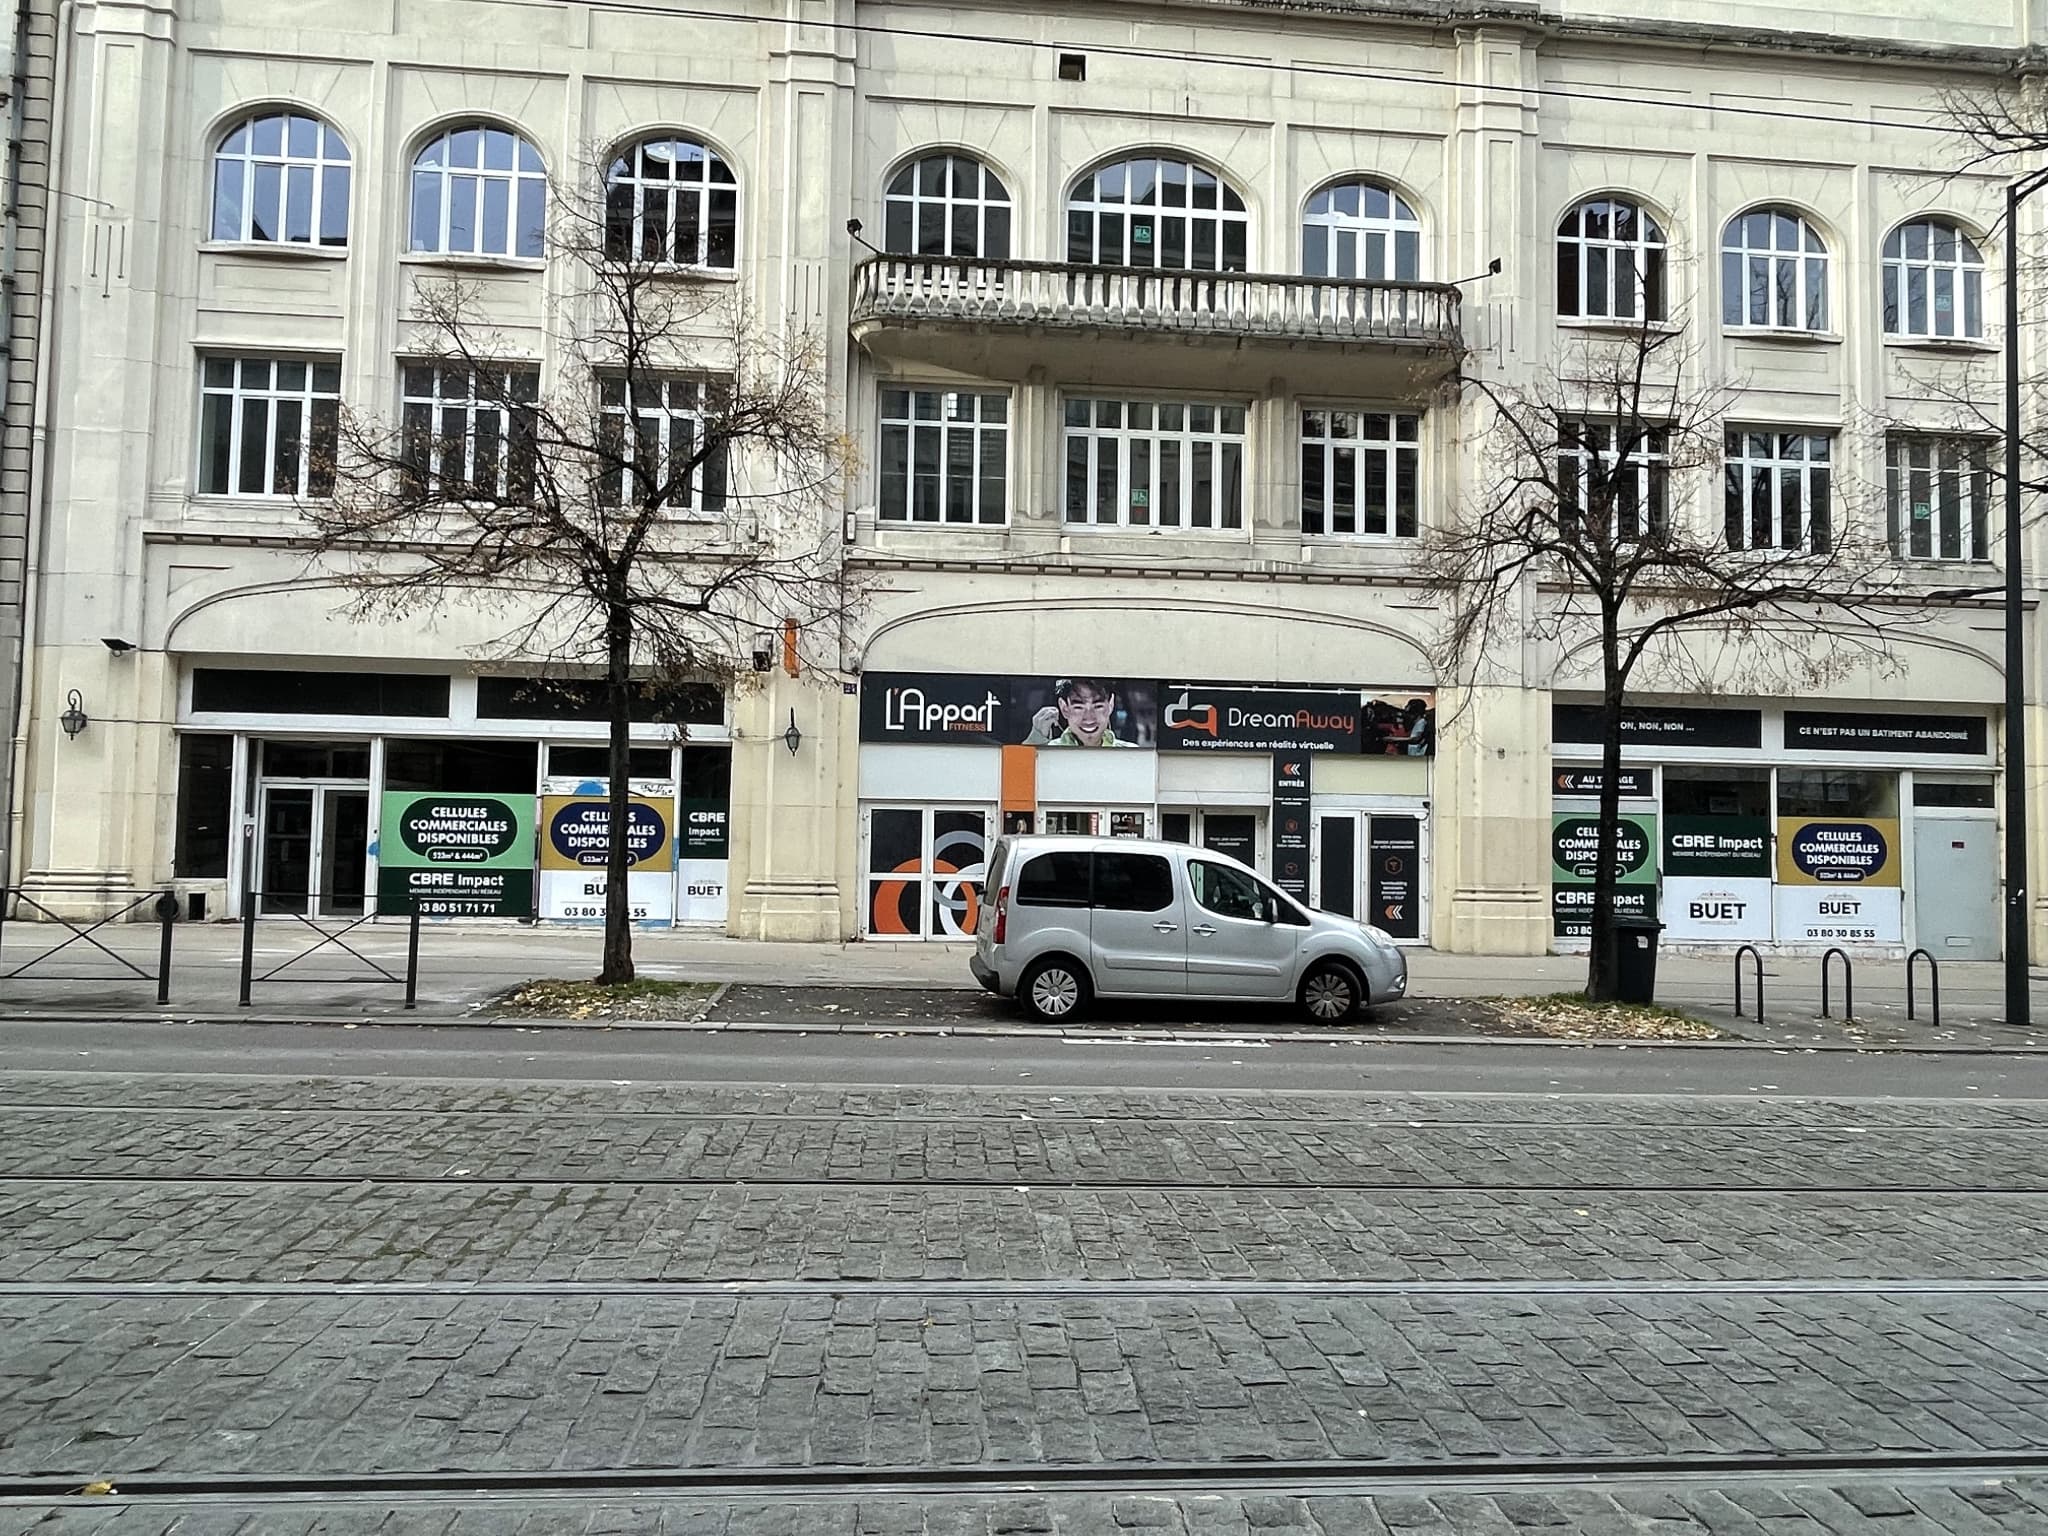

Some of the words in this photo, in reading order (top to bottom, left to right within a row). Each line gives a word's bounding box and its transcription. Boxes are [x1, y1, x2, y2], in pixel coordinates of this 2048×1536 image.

[886, 688, 1001, 732] L'Appart
[1228, 707, 1354, 734] DreamAway
[1619, 721, 1637, 731] ON,
[1639, 721, 1662, 731] NON,
[1664, 722, 1684, 731] NON
[949, 722, 986, 732] FITNESS
[1799, 727, 1811, 735] CE
[1813, 727, 1838, 736] N'EST
[1840, 728, 1856, 737] PAS
[1858, 729, 1870, 737] UN
[1182, 738, 1199, 747] Des
[1202, 739, 1254, 749] expériences
[1269, 740, 1297, 749] réalité
[1299, 742, 1335, 750] virtuelle
[1582, 775, 1595, 784] AU
[431, 806, 488, 819] CELLULES
[688, 811, 726, 823] CBRE
[410, 819, 508, 832] COMMERCIALES
[560, 823, 656, 837] COMMEALES
[417, 832, 499, 845] DISPONIBLES
[688, 826, 720, 839] Impact
[1576, 827, 1624, 838] CELLS
[1816, 831, 1862, 842] CELLULES
[1671, 835, 1716, 848] CBRE
[1719, 836, 1764, 851] Impact
[1799, 842, 1880, 854] COMMERCIALES
[455, 851, 461, 860] &
[1565, 851, 1634, 862] DISPOLES
[1806, 854, 1873, 866] DISPONIBLES
[409, 872, 454, 886] CBRE
[458, 874, 504, 888] Impact
[687, 885, 724, 896] BUET
[1555, 891, 1596, 905] CBRE
[432, 903, 447, 913] 80
[449, 903, 462, 913] 51
[465, 903, 479, 913] 71
[482, 903, 496, 913] 71
[564, 907, 578, 917] 03
[581, 907, 596, 917] 80
[633, 908, 647, 917] 55
[1689, 902, 1747, 919] BUET
[1818, 902, 1862, 915] BUET
[1566, 926, 1579, 935] 03
[1807, 928, 1819, 937] 03
[1821, 928, 1833, 938] 80
[1835, 928, 1847, 938] 30
[1849, 929, 1861, 938] 85
[1864, 929, 1875, 938] 55
